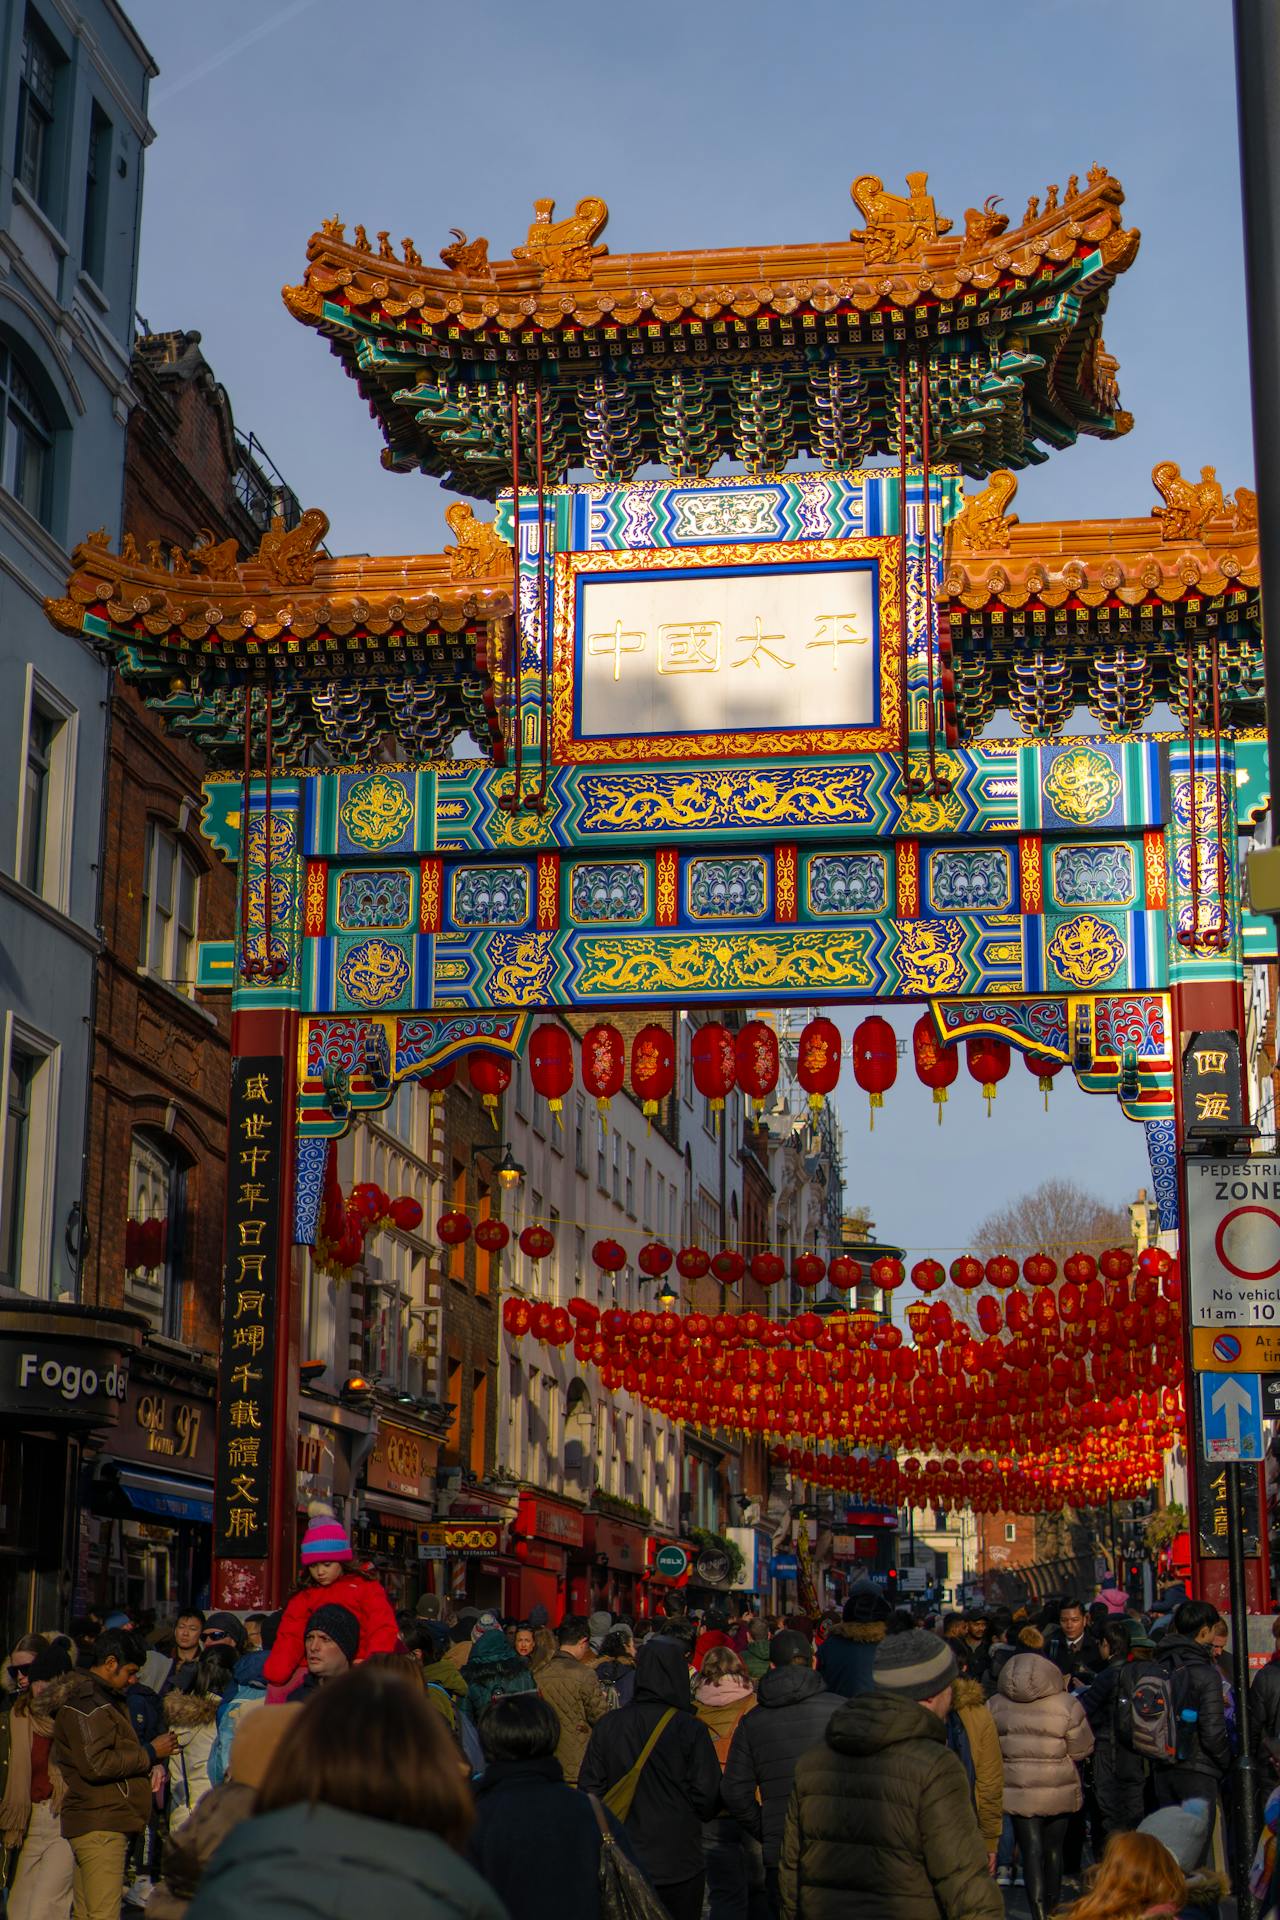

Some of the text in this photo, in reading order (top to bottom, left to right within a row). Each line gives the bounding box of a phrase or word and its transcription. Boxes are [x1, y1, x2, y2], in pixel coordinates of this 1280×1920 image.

[587, 613, 869, 682] 中國太平
[1200, 1164, 1280, 1176] PEDESTRI
[1213, 1289, 1233, 1300] No
[1253, 1304, 1275, 1319] 10
[20, 1353, 98, 1400] Fogo
[137, 1395, 166, 1431] Old
[176, 1404, 201, 1458] 97
[660, 1558, 683, 1566] RELX
